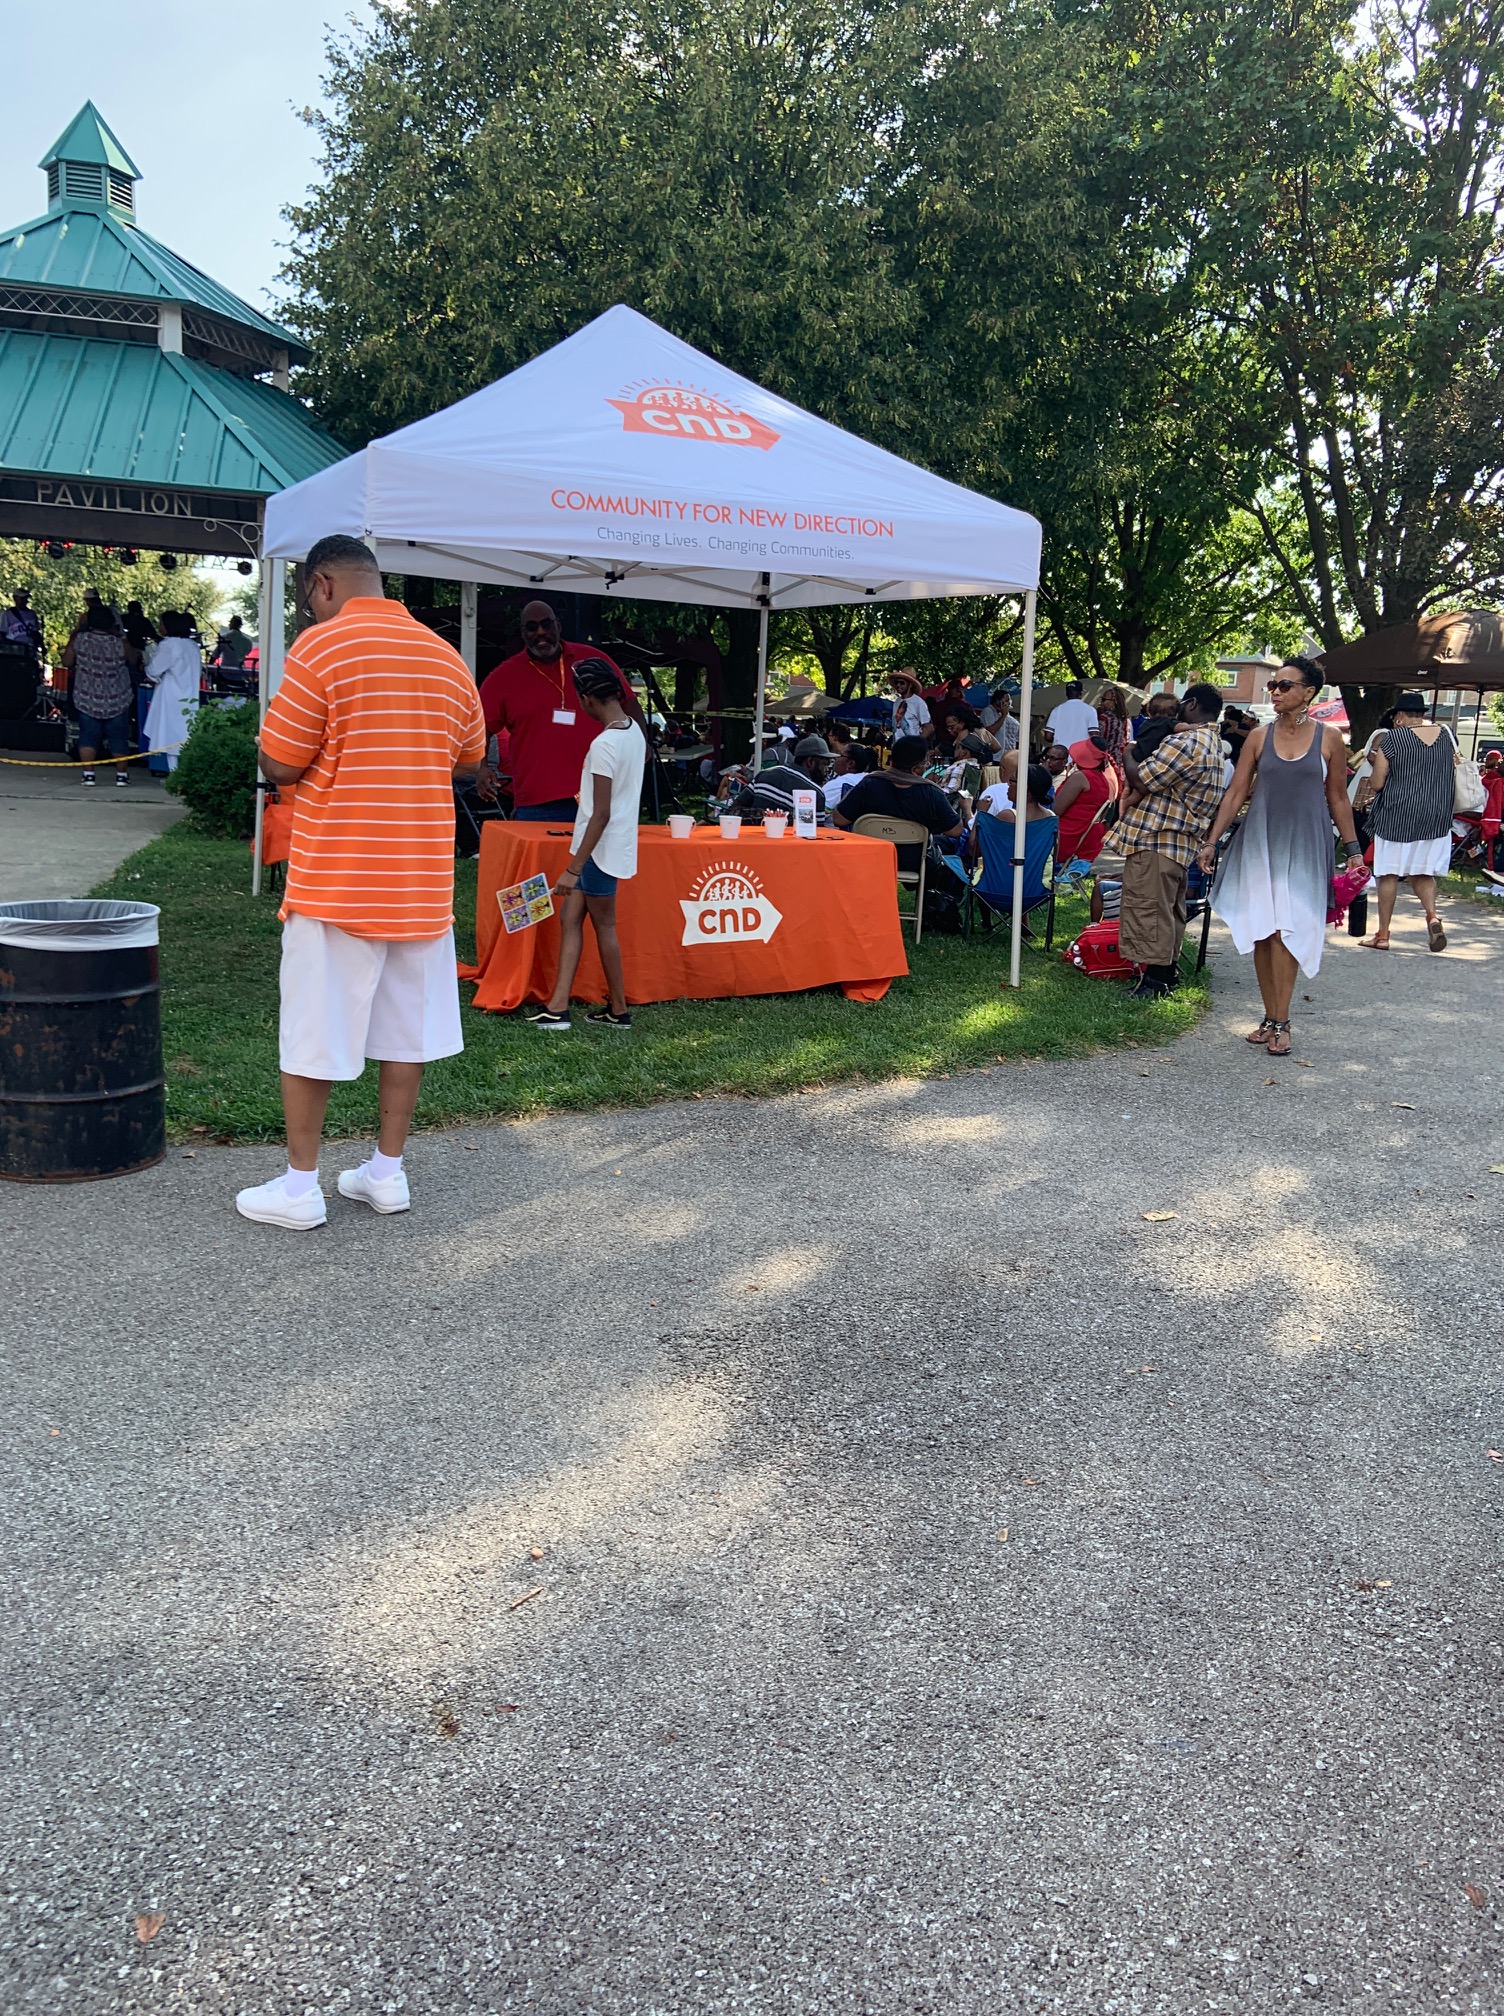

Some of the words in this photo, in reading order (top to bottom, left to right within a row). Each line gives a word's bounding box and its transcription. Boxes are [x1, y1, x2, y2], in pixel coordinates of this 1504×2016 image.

[37, 481, 192, 517] PAVILION
[551, 489, 688, 520] COMMUNITY
[693, 503, 732, 525] FOR
[739, 507, 787, 528] NEW
[794, 513, 894, 538] DIRECTION
[597, 527, 660, 547] Changing
[664, 532, 702, 548] Lives.
[708, 536, 767, 556] Changing
[771, 541, 855, 560] Communities.
